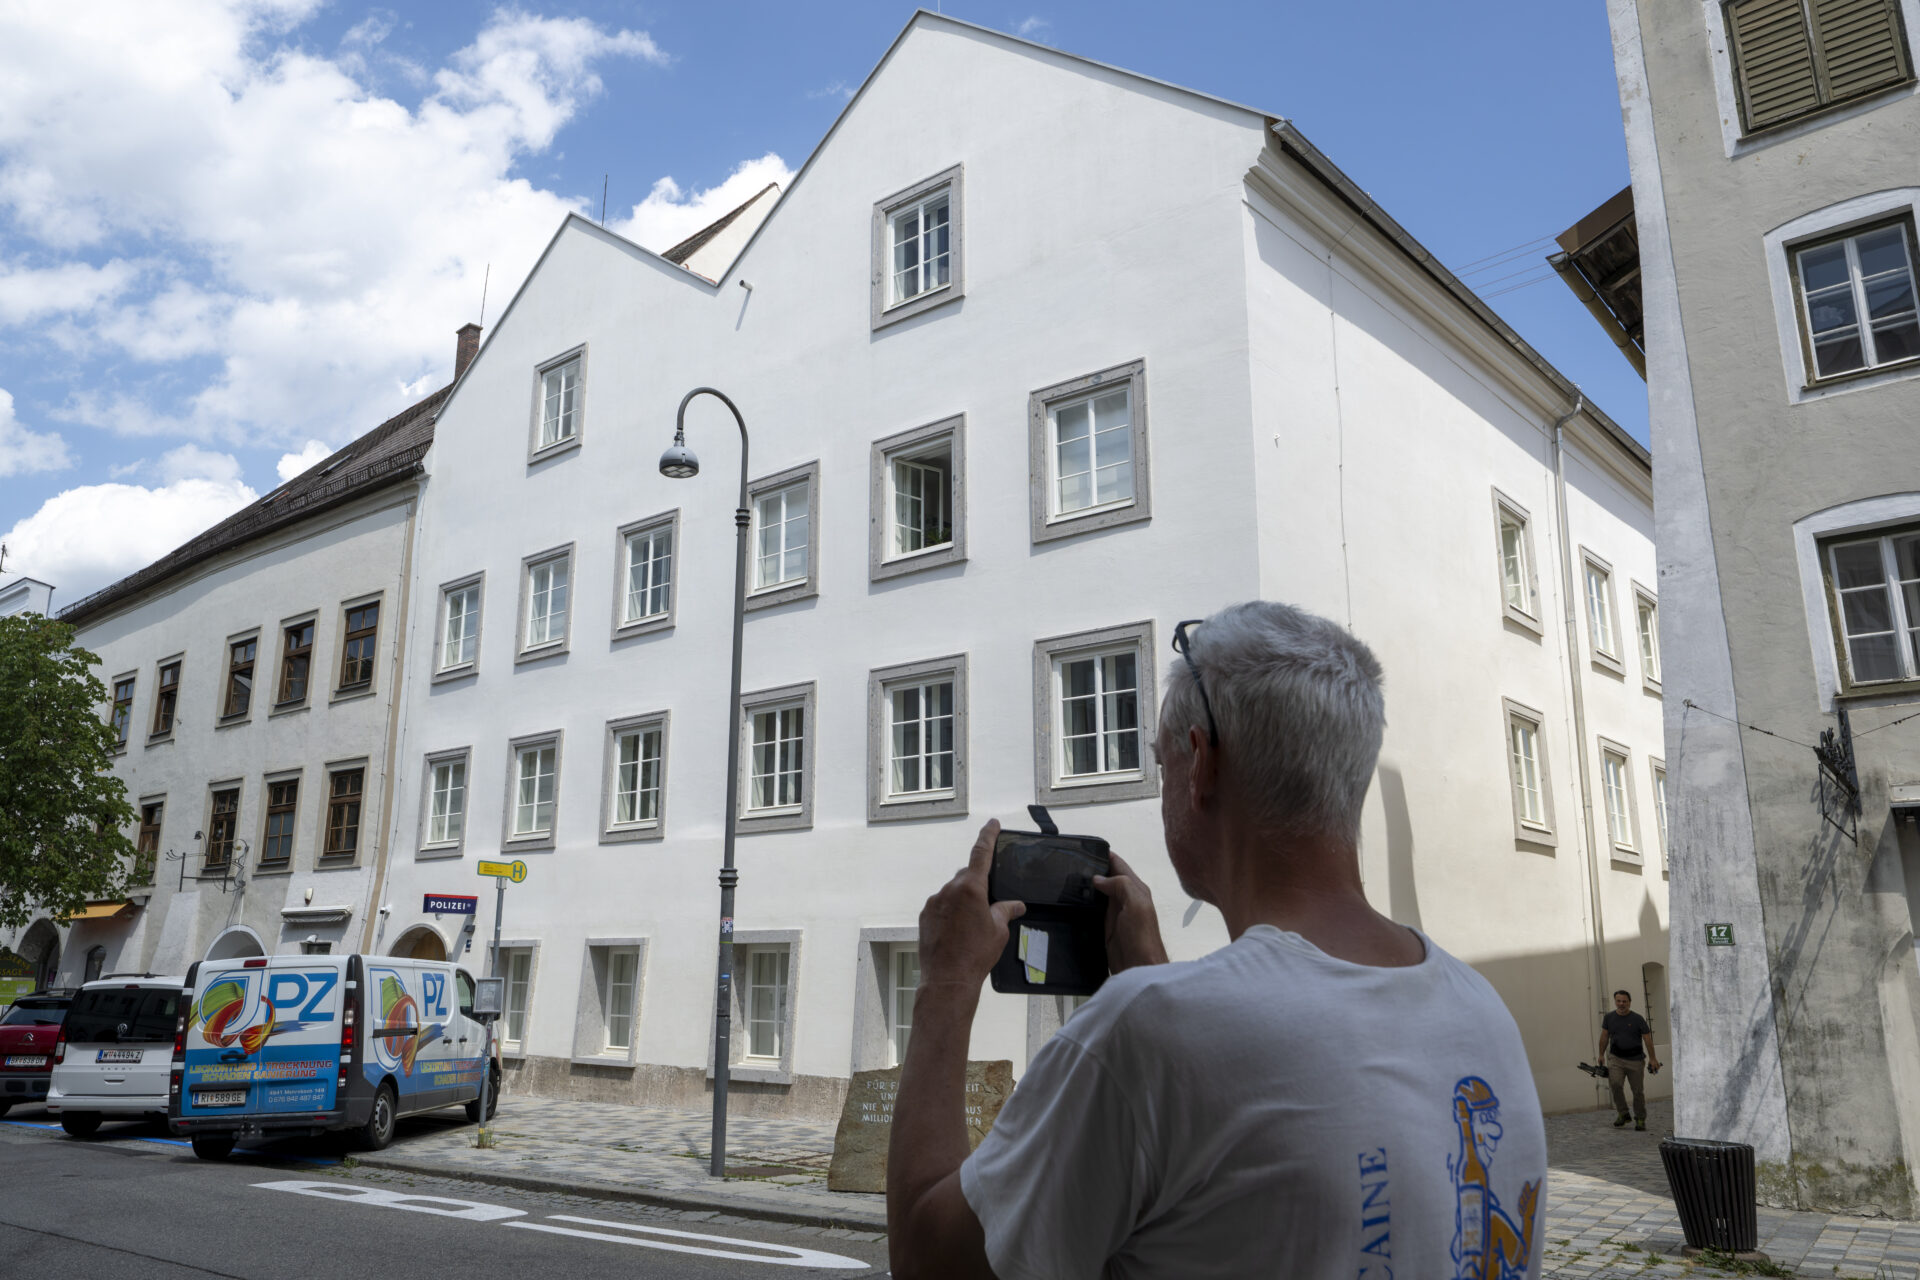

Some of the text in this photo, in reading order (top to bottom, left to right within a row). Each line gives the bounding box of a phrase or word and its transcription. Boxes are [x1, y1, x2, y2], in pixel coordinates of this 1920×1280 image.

[513, 864, 523, 879] H
[430, 901, 466, 910] POLIZEI
[1710, 926, 1728, 937] 17
[422, 972, 447, 1017] PZ
[189, 1062, 257, 1074] LECKORTUNG
[265, 1060, 333, 1071] TROCKNUNG
[202, 1069, 317, 1082] SCHADEN SANIERUNG
[866, 1081, 886, 1090] FÜR
[965, 1083, 980, 1092] EIT
[201, 1092, 242, 1103] RI 589 GE
[862, 1102, 877, 1111] NIE
[882, 1103, 894, 1112] WI
